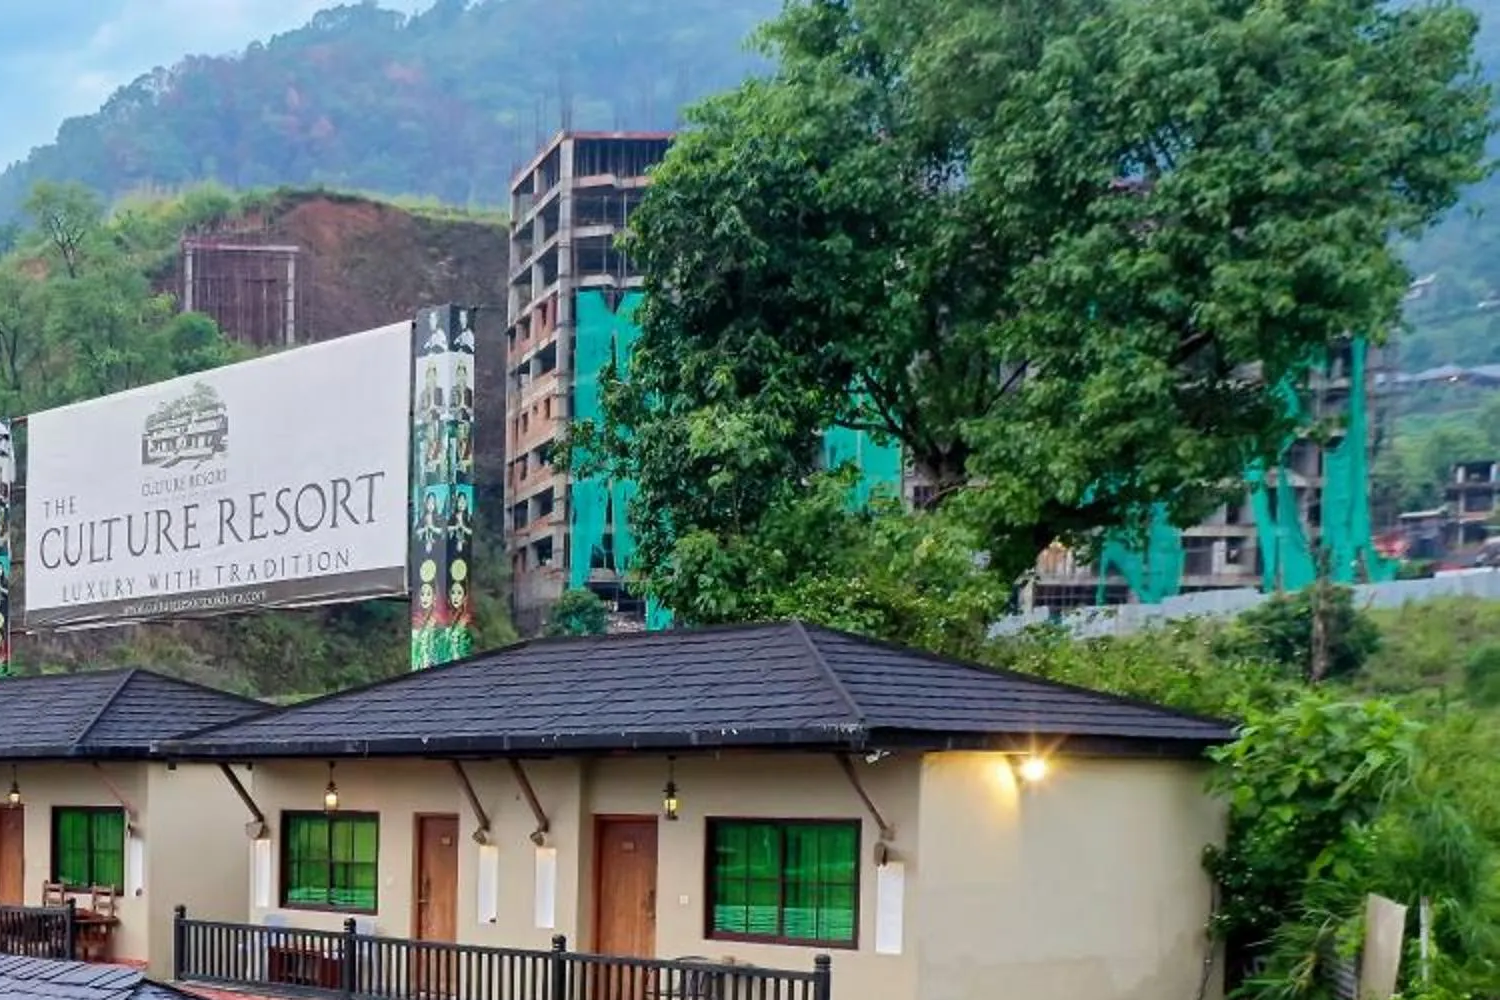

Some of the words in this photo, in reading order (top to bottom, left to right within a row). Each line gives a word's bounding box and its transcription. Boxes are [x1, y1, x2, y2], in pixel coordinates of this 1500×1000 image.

[39, 503, 201, 570] CULTURE
[217, 471, 385, 546] RESORT
[43, 496, 77, 518] THE
[61, 576, 135, 602] LUXURY
[149, 568, 200, 592] WITH
[214, 548, 350, 585] TRADITION
